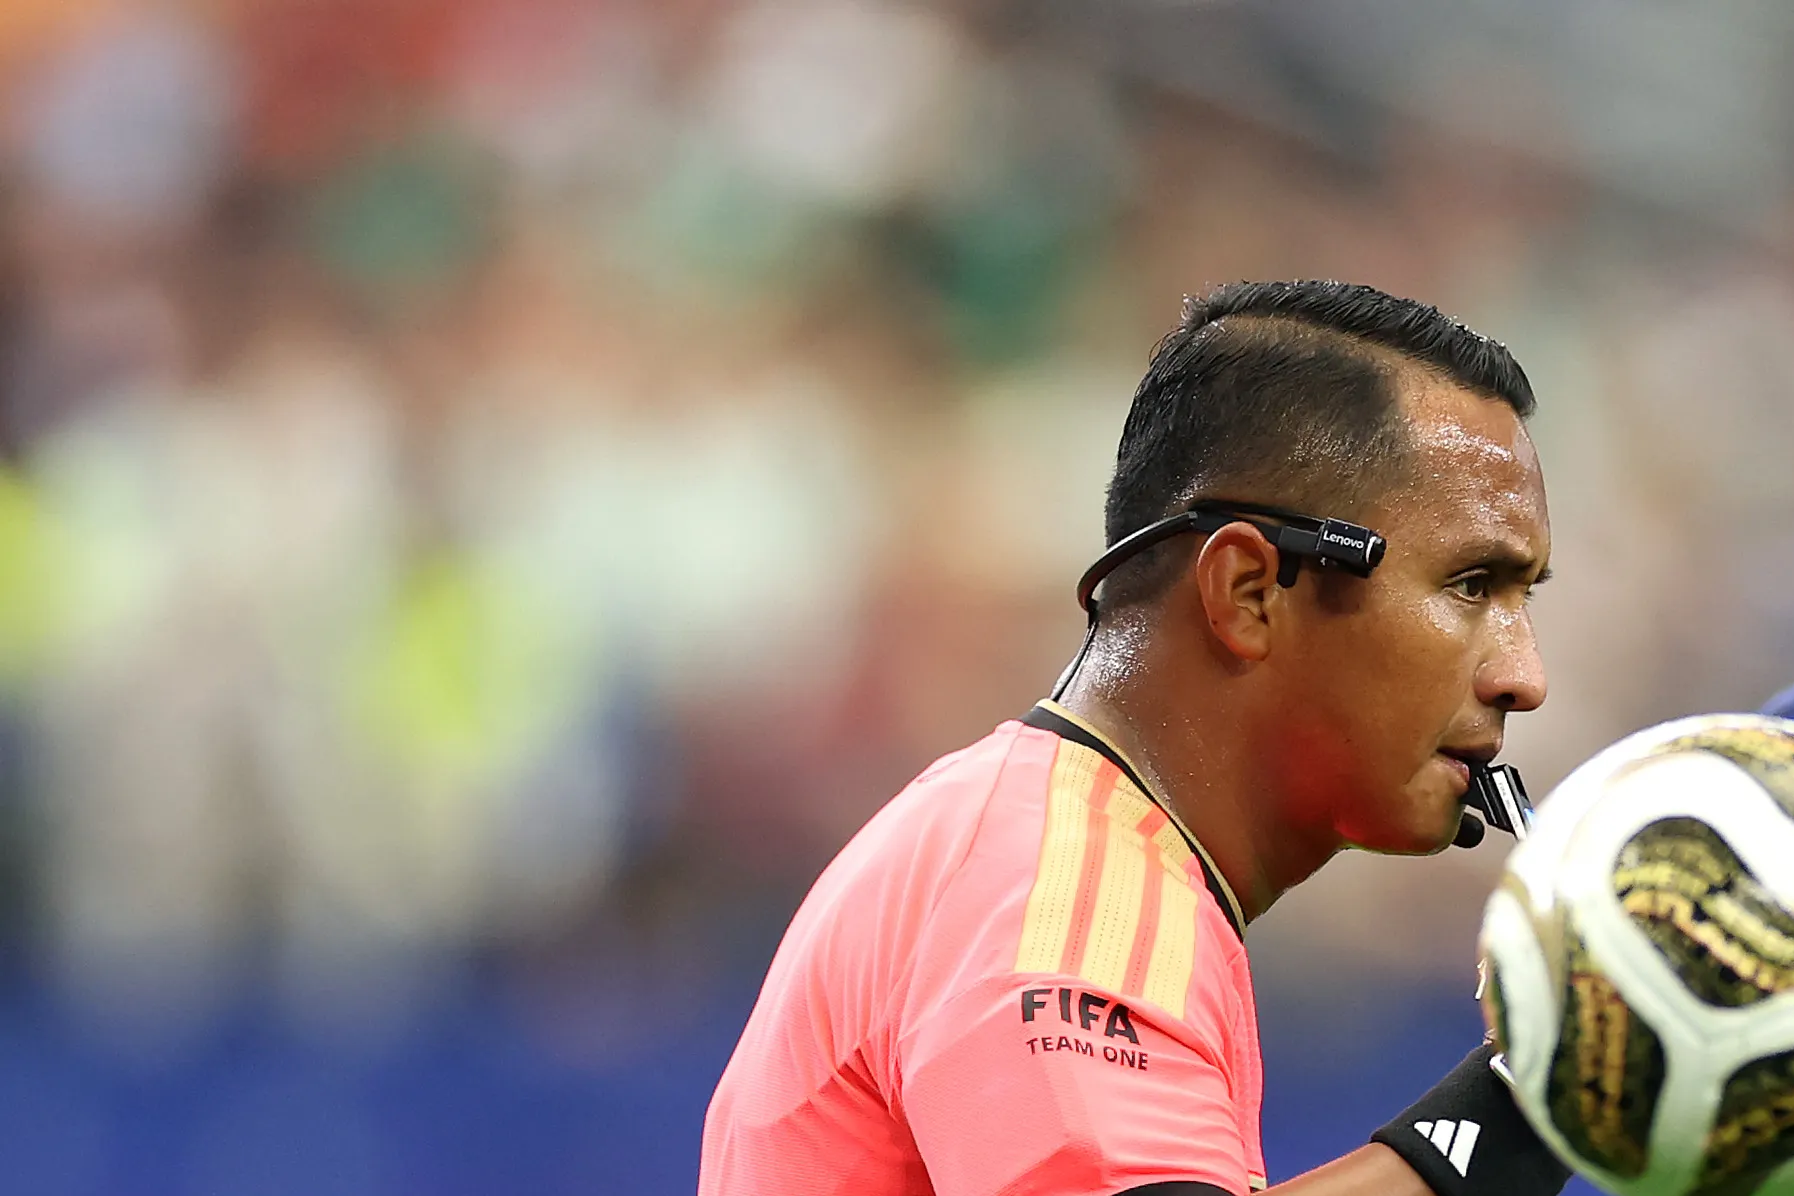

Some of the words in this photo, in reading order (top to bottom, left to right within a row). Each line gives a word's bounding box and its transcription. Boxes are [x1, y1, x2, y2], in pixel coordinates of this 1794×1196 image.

[1322, 529, 1365, 550] Lenovo
[1020, 986, 1141, 1046] FIFA
[1026, 1035, 1095, 1058] TEAM
[1102, 1045, 1149, 1072] ONE
